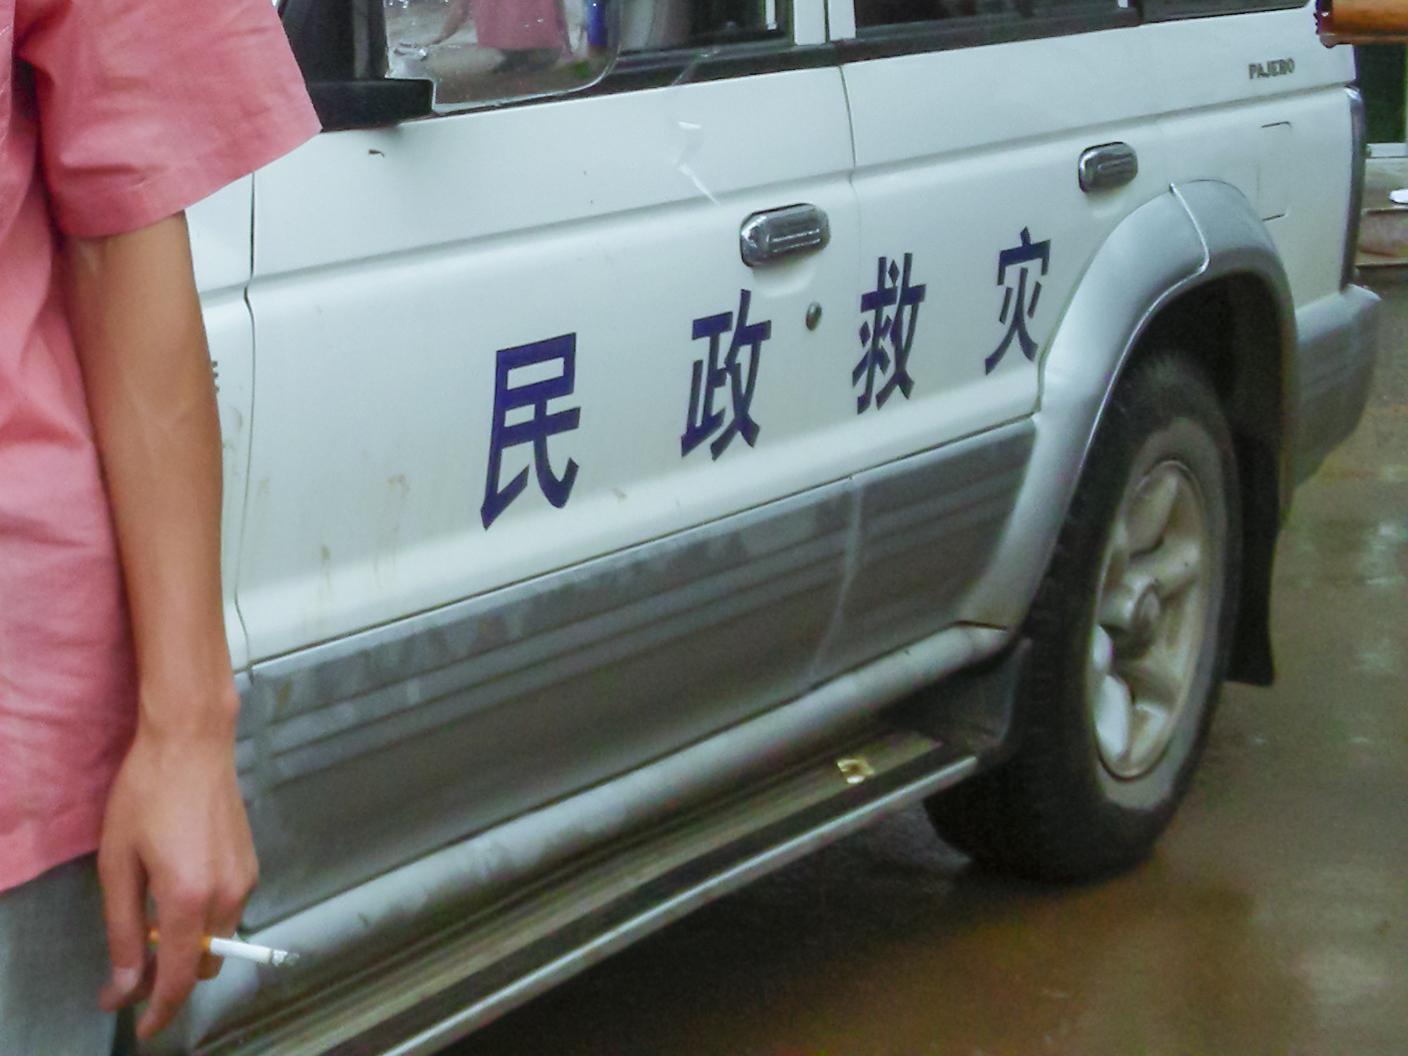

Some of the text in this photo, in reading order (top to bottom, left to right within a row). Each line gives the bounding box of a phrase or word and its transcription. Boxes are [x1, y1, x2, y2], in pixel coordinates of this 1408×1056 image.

[1248, 57, 1295, 80] PAJERO
[480, 227, 1051, 530] 民政救灾
